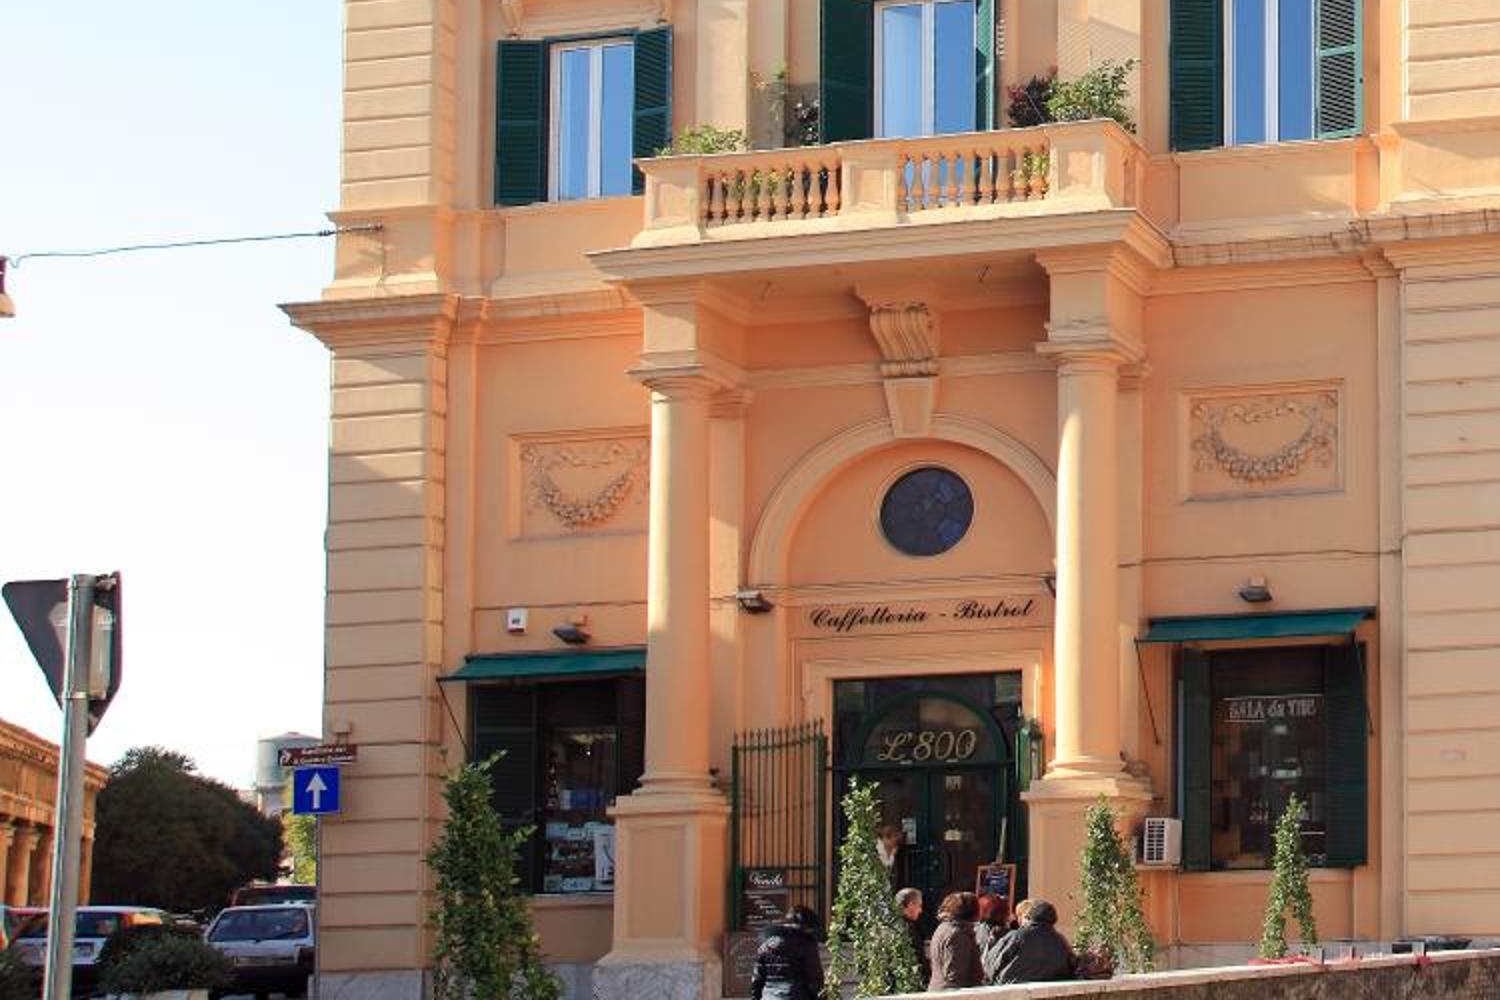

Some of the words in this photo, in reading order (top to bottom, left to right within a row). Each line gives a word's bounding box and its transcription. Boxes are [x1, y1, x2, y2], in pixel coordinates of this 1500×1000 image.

[810, 605, 927, 632] Caffetteria
[953, 599, 1033, 619] Bistrot
[876, 729, 977, 760] L'800
